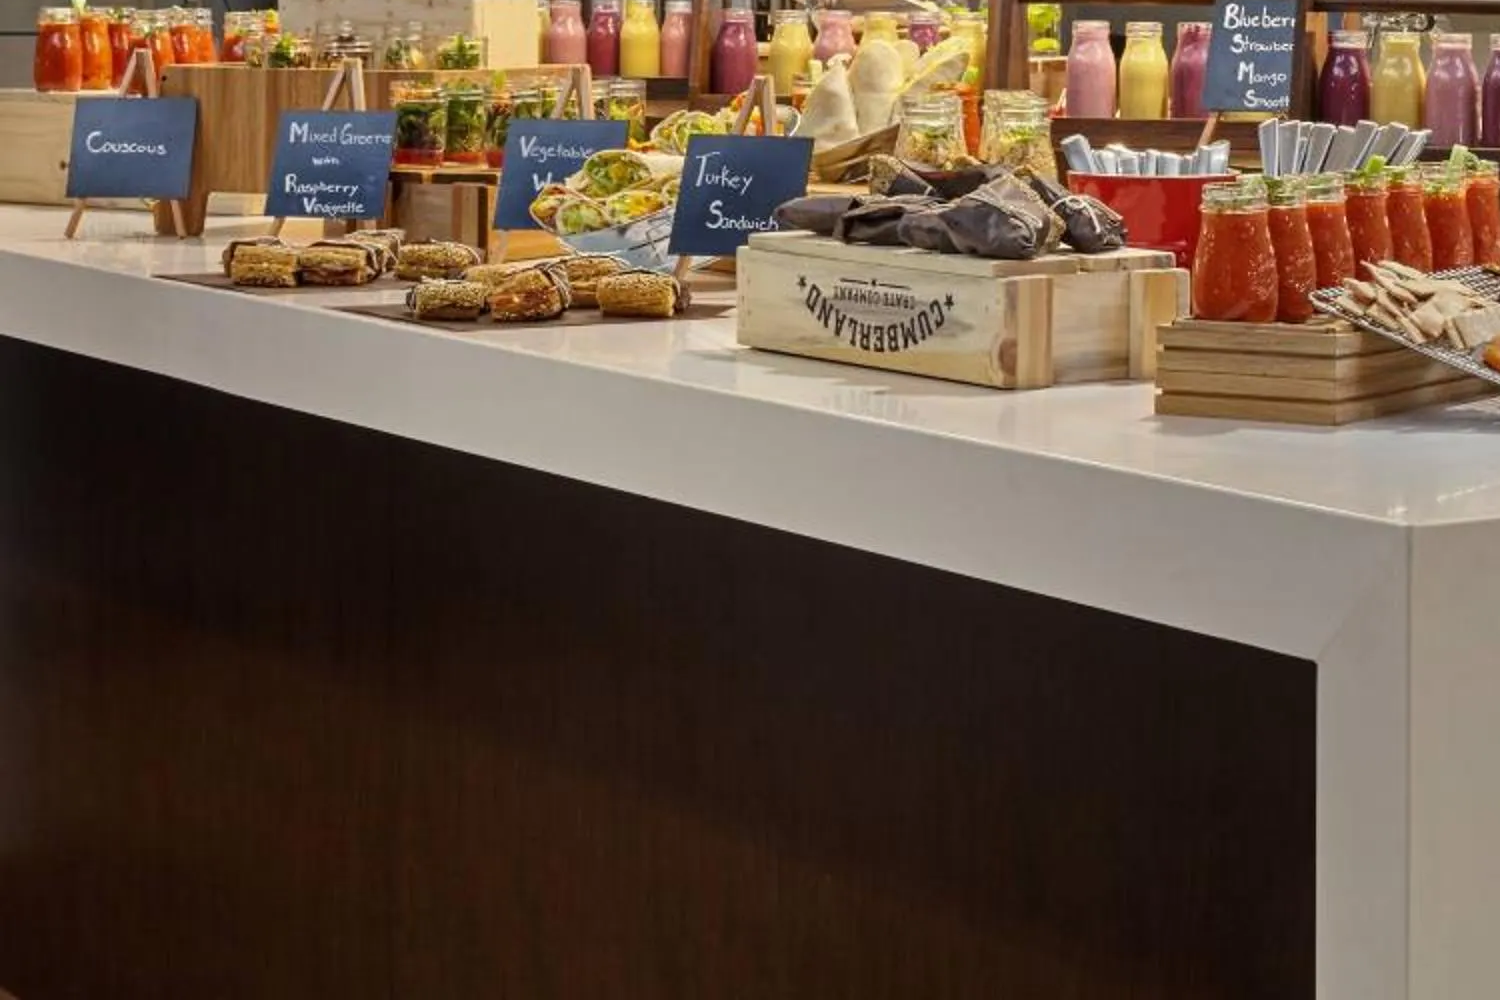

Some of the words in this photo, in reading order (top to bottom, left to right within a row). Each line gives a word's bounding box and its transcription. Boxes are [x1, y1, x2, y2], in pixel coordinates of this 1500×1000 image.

[1223, 3, 1297, 29] Blueberr
[1229, 33, 1296, 54] Strawber
[1236, 61, 1288, 87] Mango
[85, 130, 168, 156] Couscous
[288, 121, 338, 144] Mixed
[284, 173, 359, 198] Raspberry
[695, 151, 754, 197] Turkey
[704, 199, 781, 232] Sandwich
[884, 292, 916, 310] CRATE
[805, 283, 946, 353] CUMBERLAND
